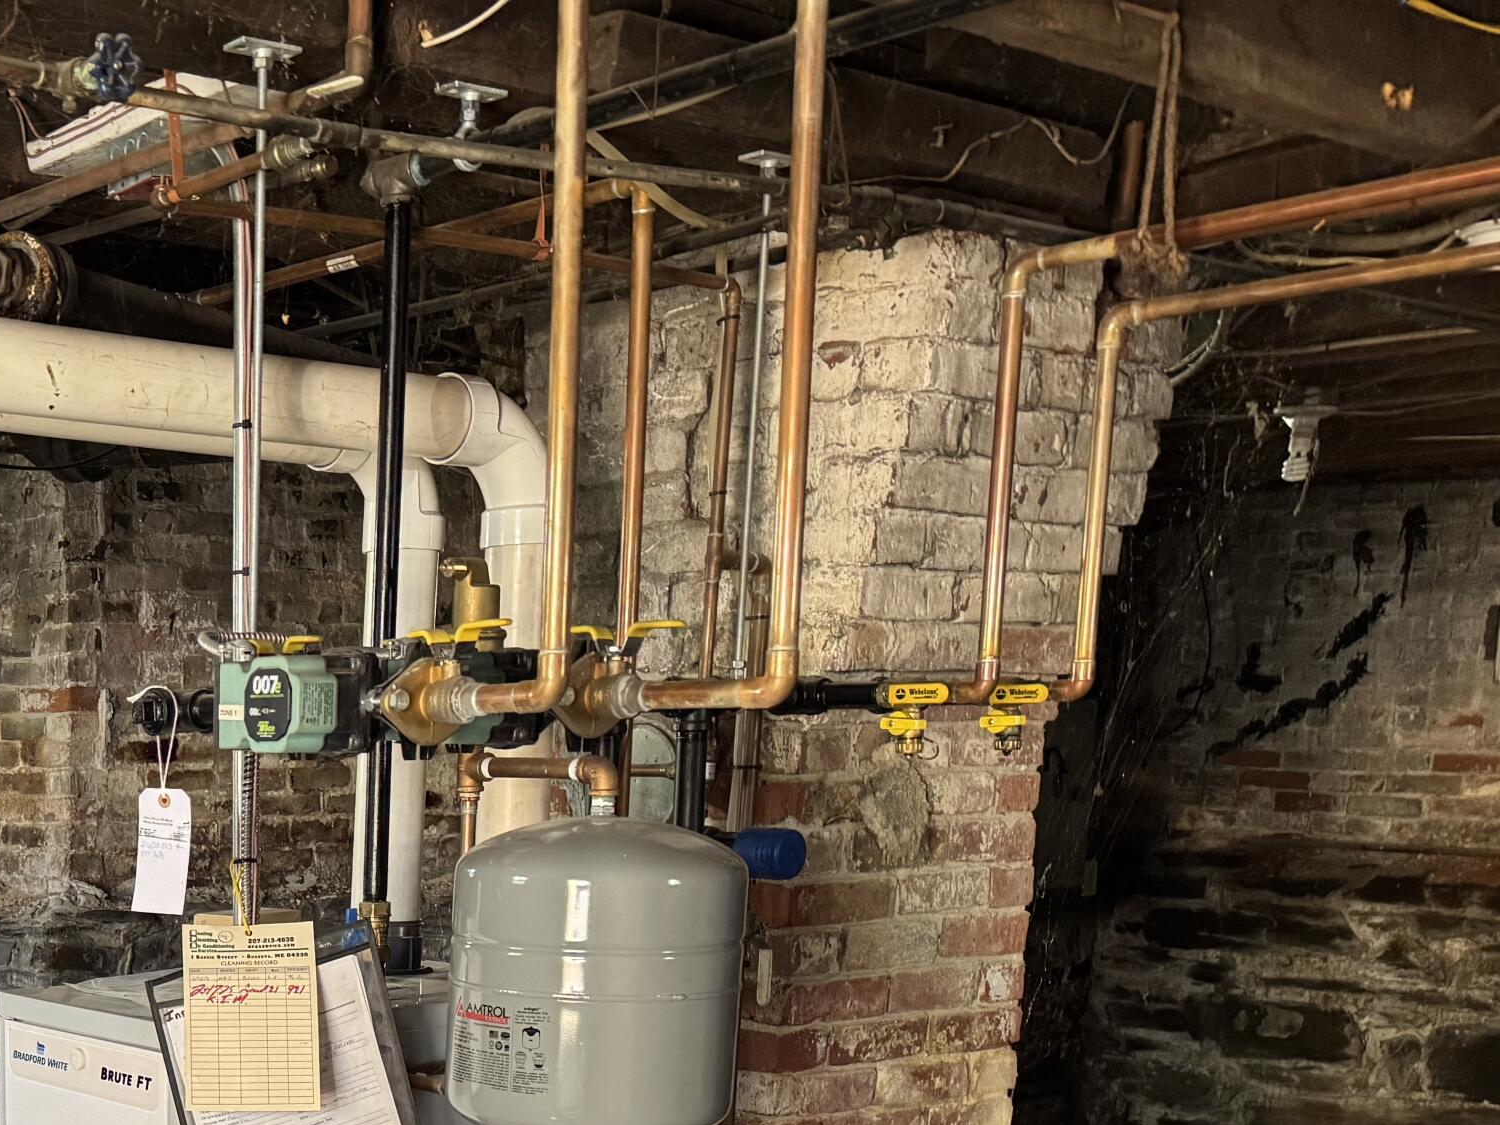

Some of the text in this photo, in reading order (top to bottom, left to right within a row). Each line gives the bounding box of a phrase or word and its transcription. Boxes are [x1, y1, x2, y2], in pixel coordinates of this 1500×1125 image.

[466, 1003, 510, 1018] AMTROL
[13, 1050, 68, 1071] BRADFORD WHITE
[100, 1067, 152, 1090] BRUTE FT
